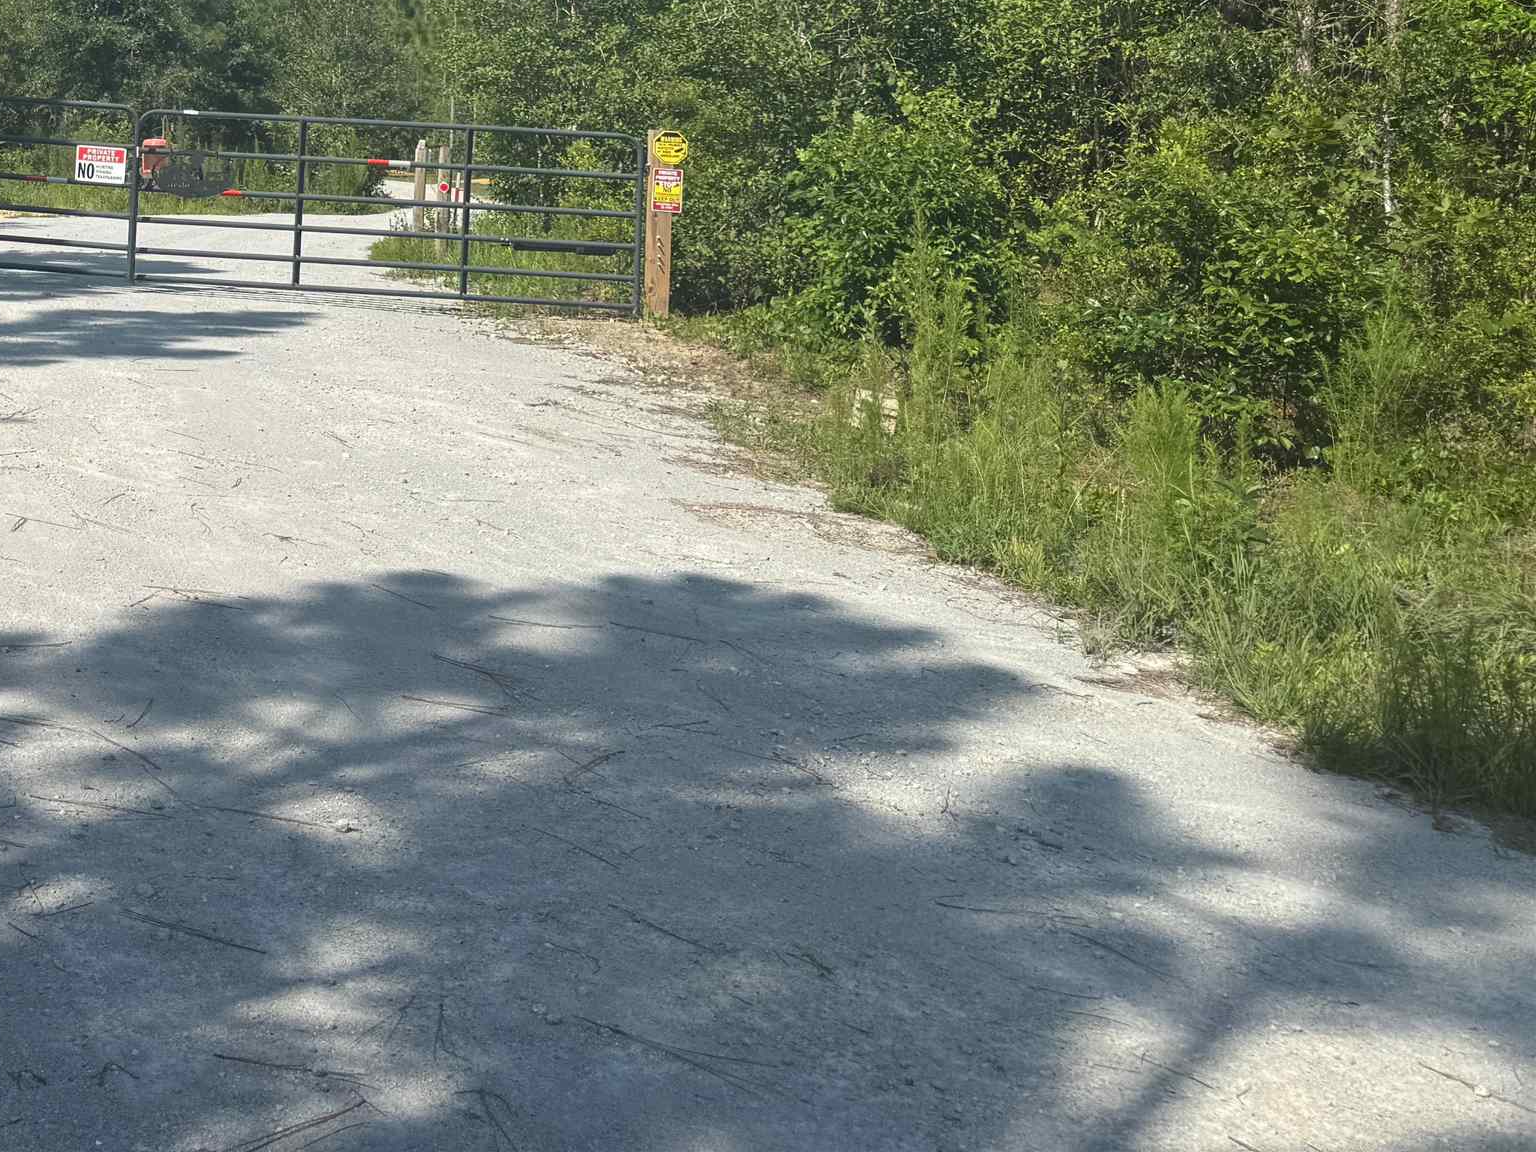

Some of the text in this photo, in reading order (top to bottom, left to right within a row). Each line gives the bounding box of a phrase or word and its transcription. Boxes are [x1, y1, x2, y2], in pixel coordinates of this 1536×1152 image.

[86, 148, 116, 156] PRIVATE
[82, 154, 121, 163] PROPERTY
[77, 161, 95, 179] NO
